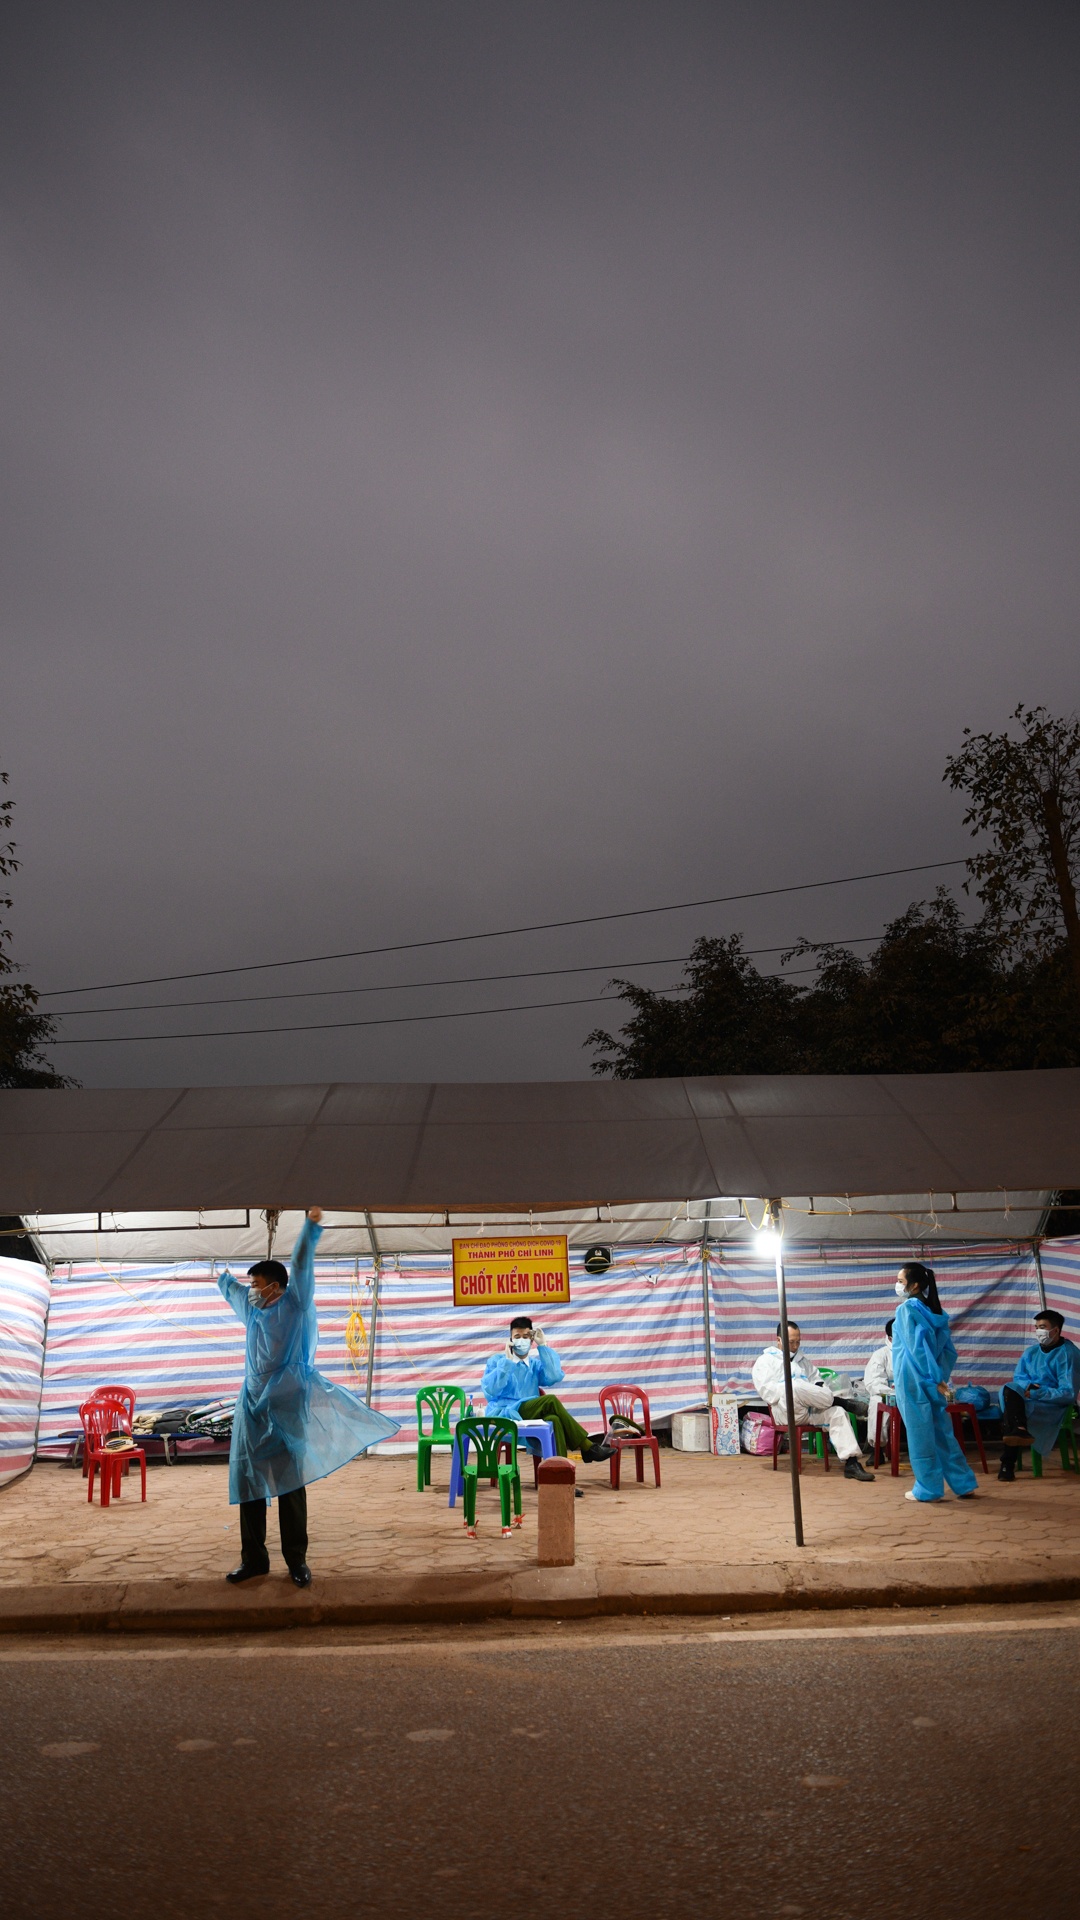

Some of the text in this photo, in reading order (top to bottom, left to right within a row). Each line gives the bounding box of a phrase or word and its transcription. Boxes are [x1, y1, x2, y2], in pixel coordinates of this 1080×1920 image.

[468, 1250, 496, 1259] THÀNH
[498, 1247, 515, 1258] PHỐ
[518, 1248, 531, 1257] CHÍ
[460, 1265, 564, 1297] CHỐT KIỂM DỊCH
